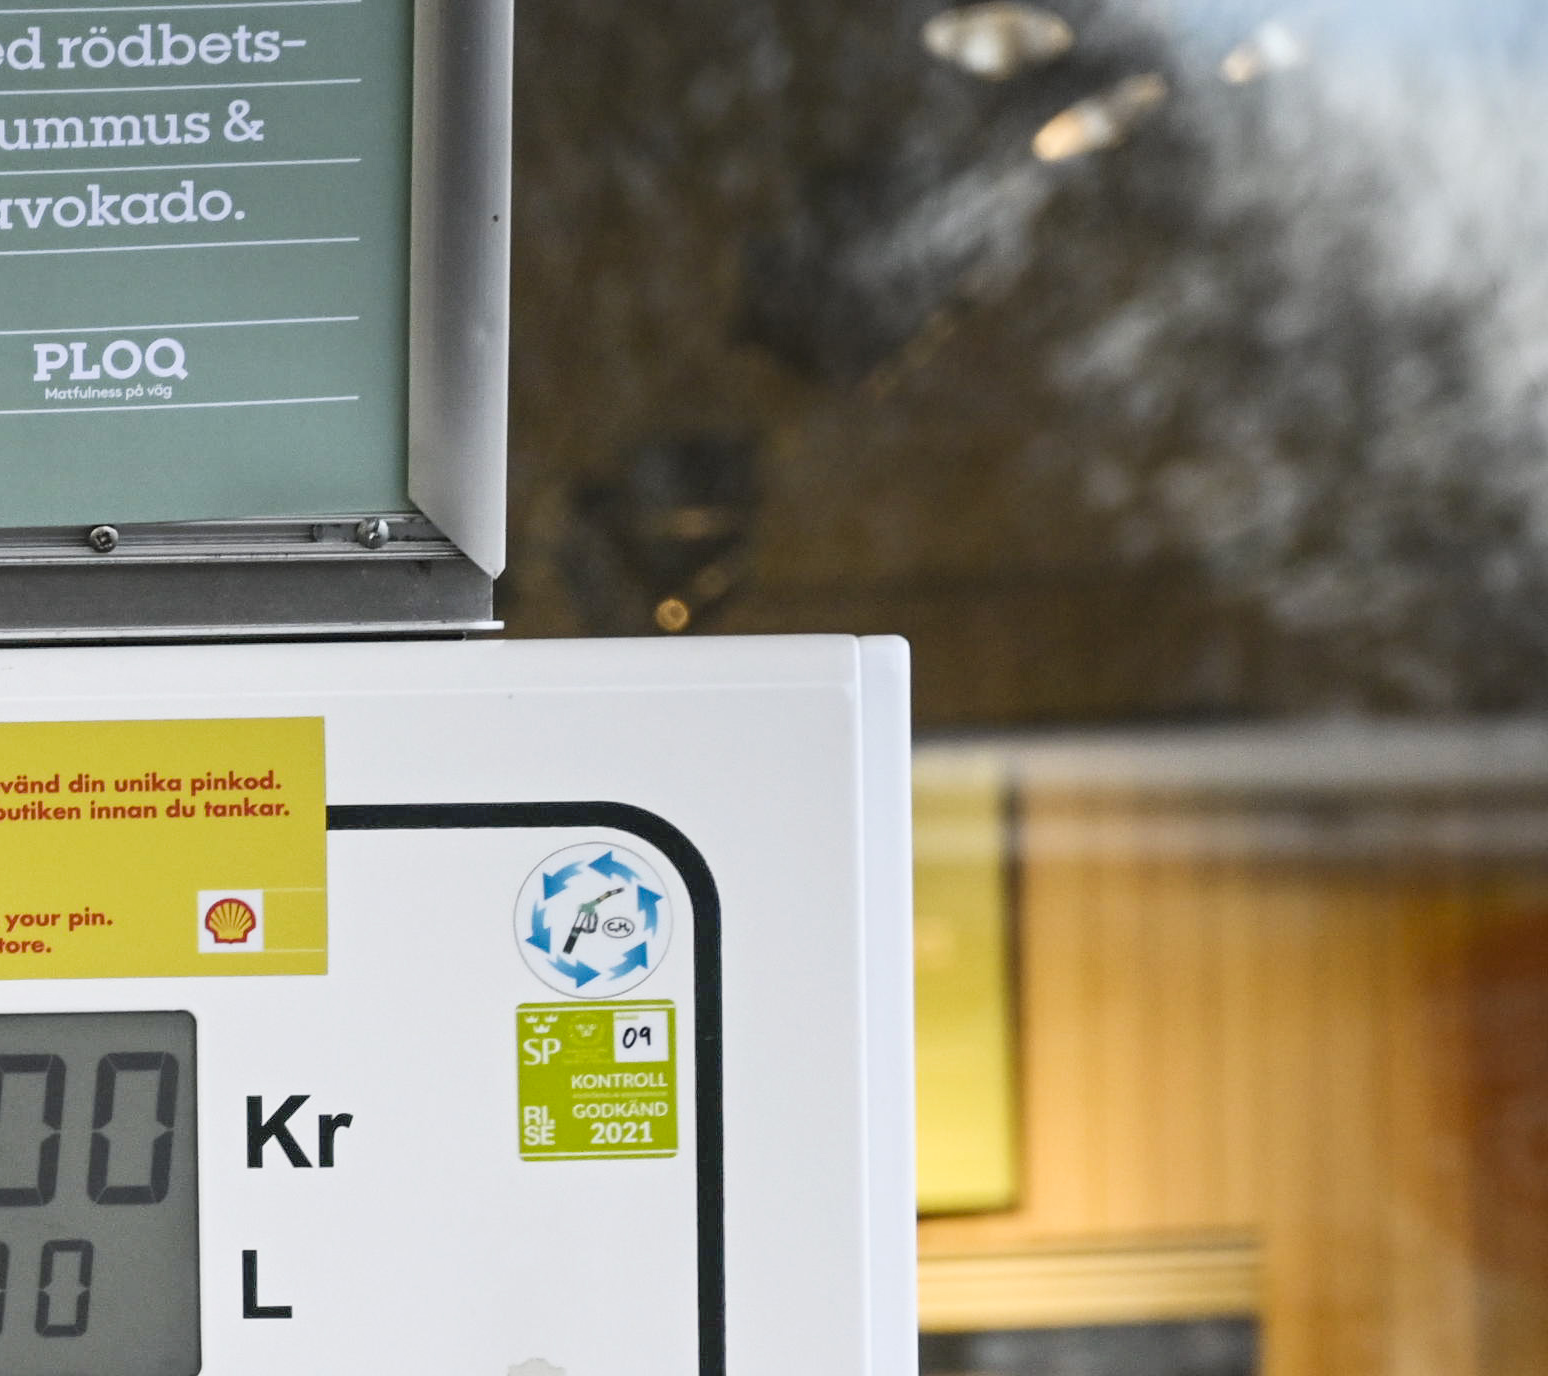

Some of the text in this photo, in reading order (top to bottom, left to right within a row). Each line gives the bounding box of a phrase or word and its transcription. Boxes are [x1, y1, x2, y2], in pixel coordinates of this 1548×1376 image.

[58, 24, 306, 69] rödbets-
[224, 100, 264, 142] &
[34, 338, 188, 381] PLOQ
[45, 384, 172, 400] Matfulness på väg
[68, 774, 105, 793] din
[114, 772, 182, 792] unika
[191, 770, 281, 796] pinkod.
[91, 800, 157, 819] innan
[166, 799, 196, 818] du
[204, 797, 290, 817] tankar.
[5, 914, 60, 932] your
[69, 907, 113, 931] pin.
[623, 1027, 651, 1048] 09
[523, 1038, 561, 1065] SP
[571, 1073, 668, 1089] KONTROLL
[572, 1100, 668, 1118] GODKÄND
[247, 1095, 353, 1168] Kr
[591, 1121, 652, 1144] 2021
[242, 1250, 292, 1319] L
